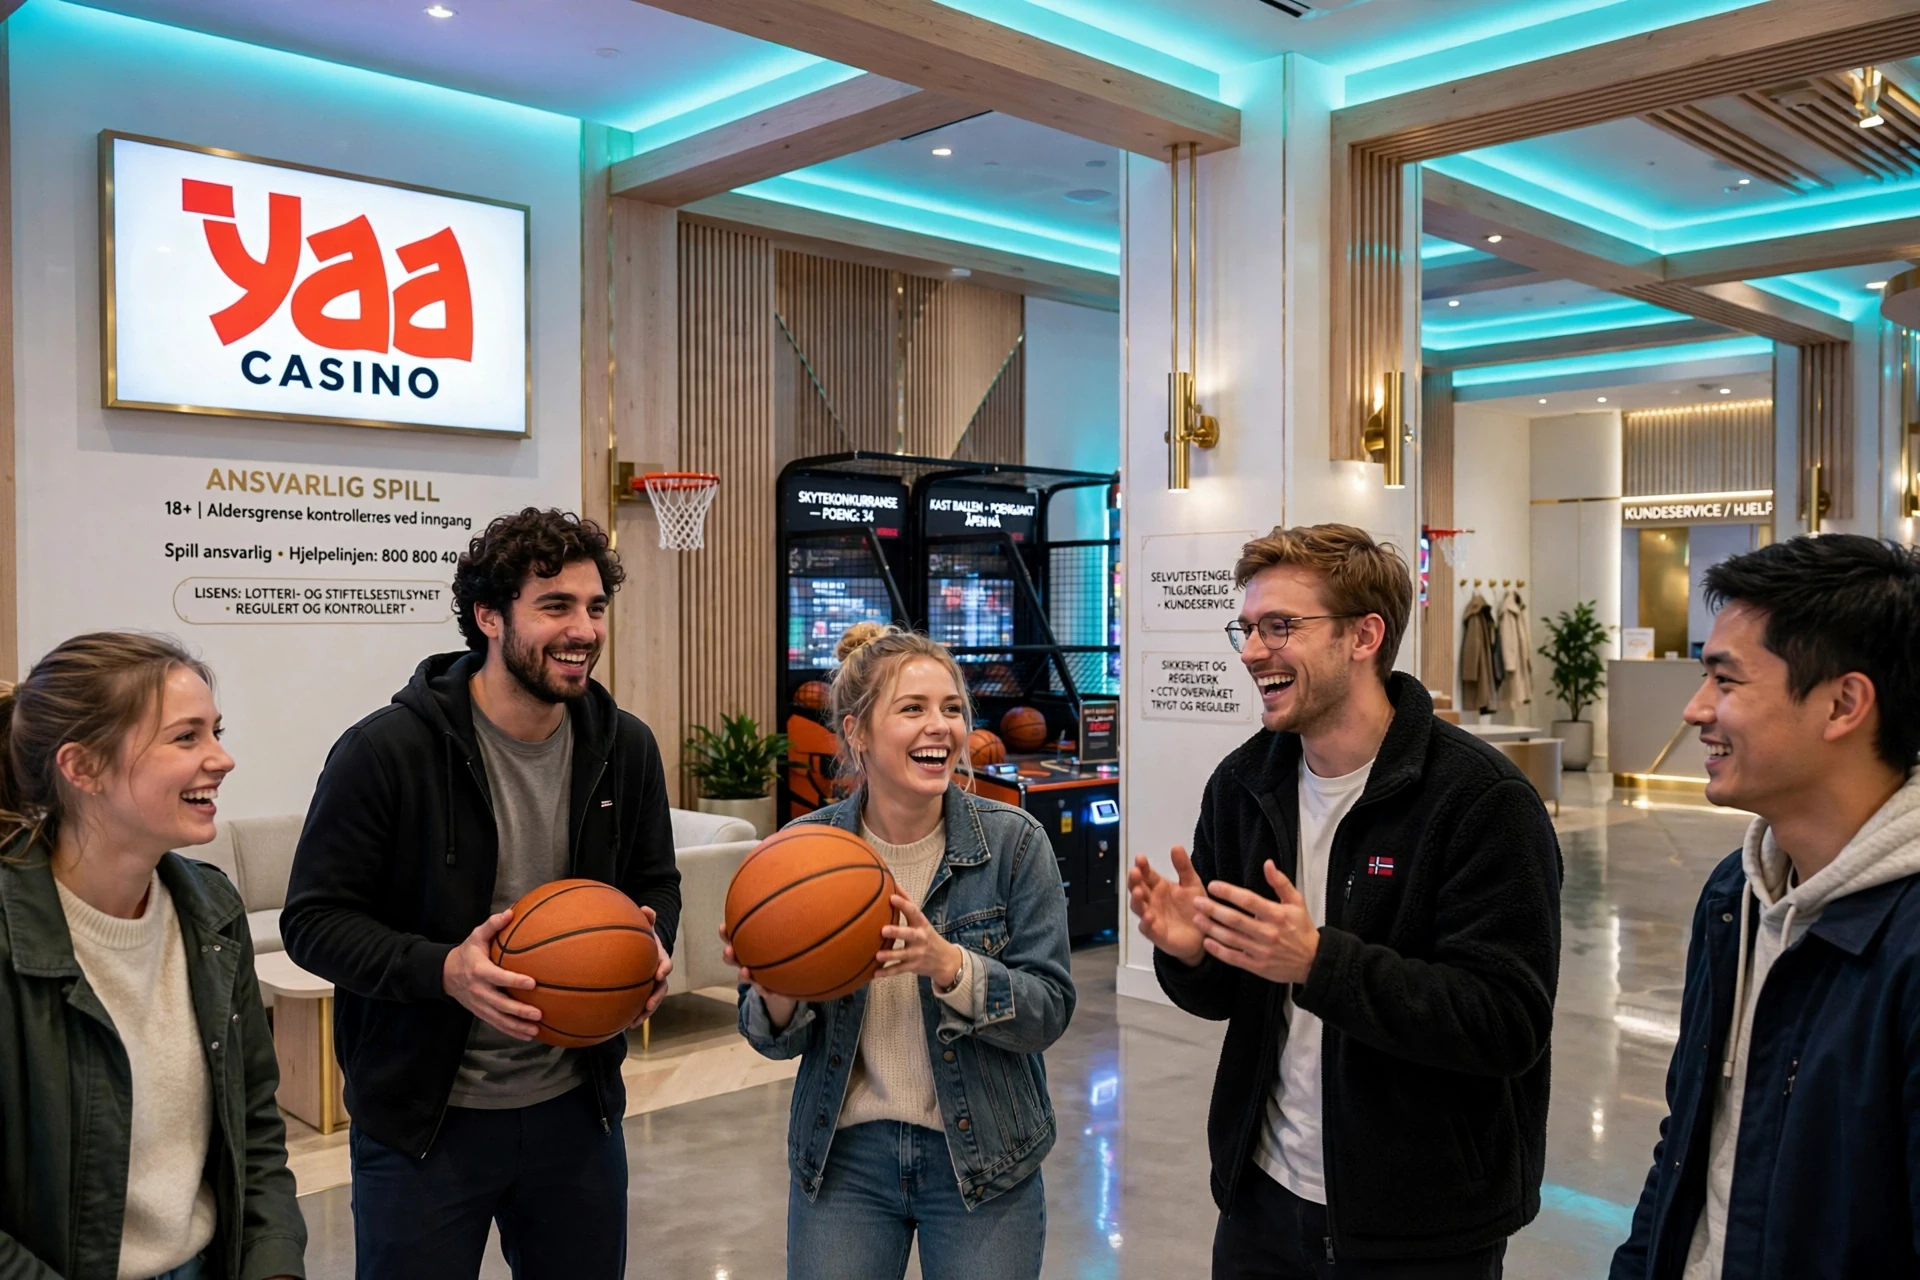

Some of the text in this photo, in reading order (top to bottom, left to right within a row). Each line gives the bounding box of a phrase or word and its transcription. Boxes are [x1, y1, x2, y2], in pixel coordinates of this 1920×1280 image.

[241, 350, 439, 399] CASINO
[206, 468, 440, 502] ANSVARLIG SPILL
[798, 491, 898, 509] SKYTEKONKURRANSE
[929, 499, 951, 511] KAST
[952, 501, 983, 513] BALLEN
[165, 501, 192, 516] 18+
[207, 502, 303, 522] Aldersgrense
[394, 511, 418, 525] ved
[421, 511, 472, 530] inngang
[822, 507, 860, 521] POENG:
[861, 509, 875, 522] 34
[1625, 504, 1721, 520] KUNDESERVICE
[1734, 501, 1773, 516] HJELP
[165, 543, 458, 565] Spill ansvarlig Hjelpelinjen: 800 800 40
[1151, 570, 1237, 582] SELVUTESTENGEL
[195, 587, 441, 601] LISENS: LOTTERI- OG STIFTELSESTILSYNET
[1162, 585, 1229, 595] TILGJENGELIG
[236, 603, 407, 615] REGULERT OG KONTROLLERT
[1164, 599, 1235, 609] KUNDESERVICE
[1162, 660, 1227, 672] SIKKERHET OG
[1168, 673, 1219, 685] REGELVERK
[1157, 685, 1234, 699] CCTV OVERVÅKET
[1151, 699, 1240, 713] TRYGT OG REGULERT
